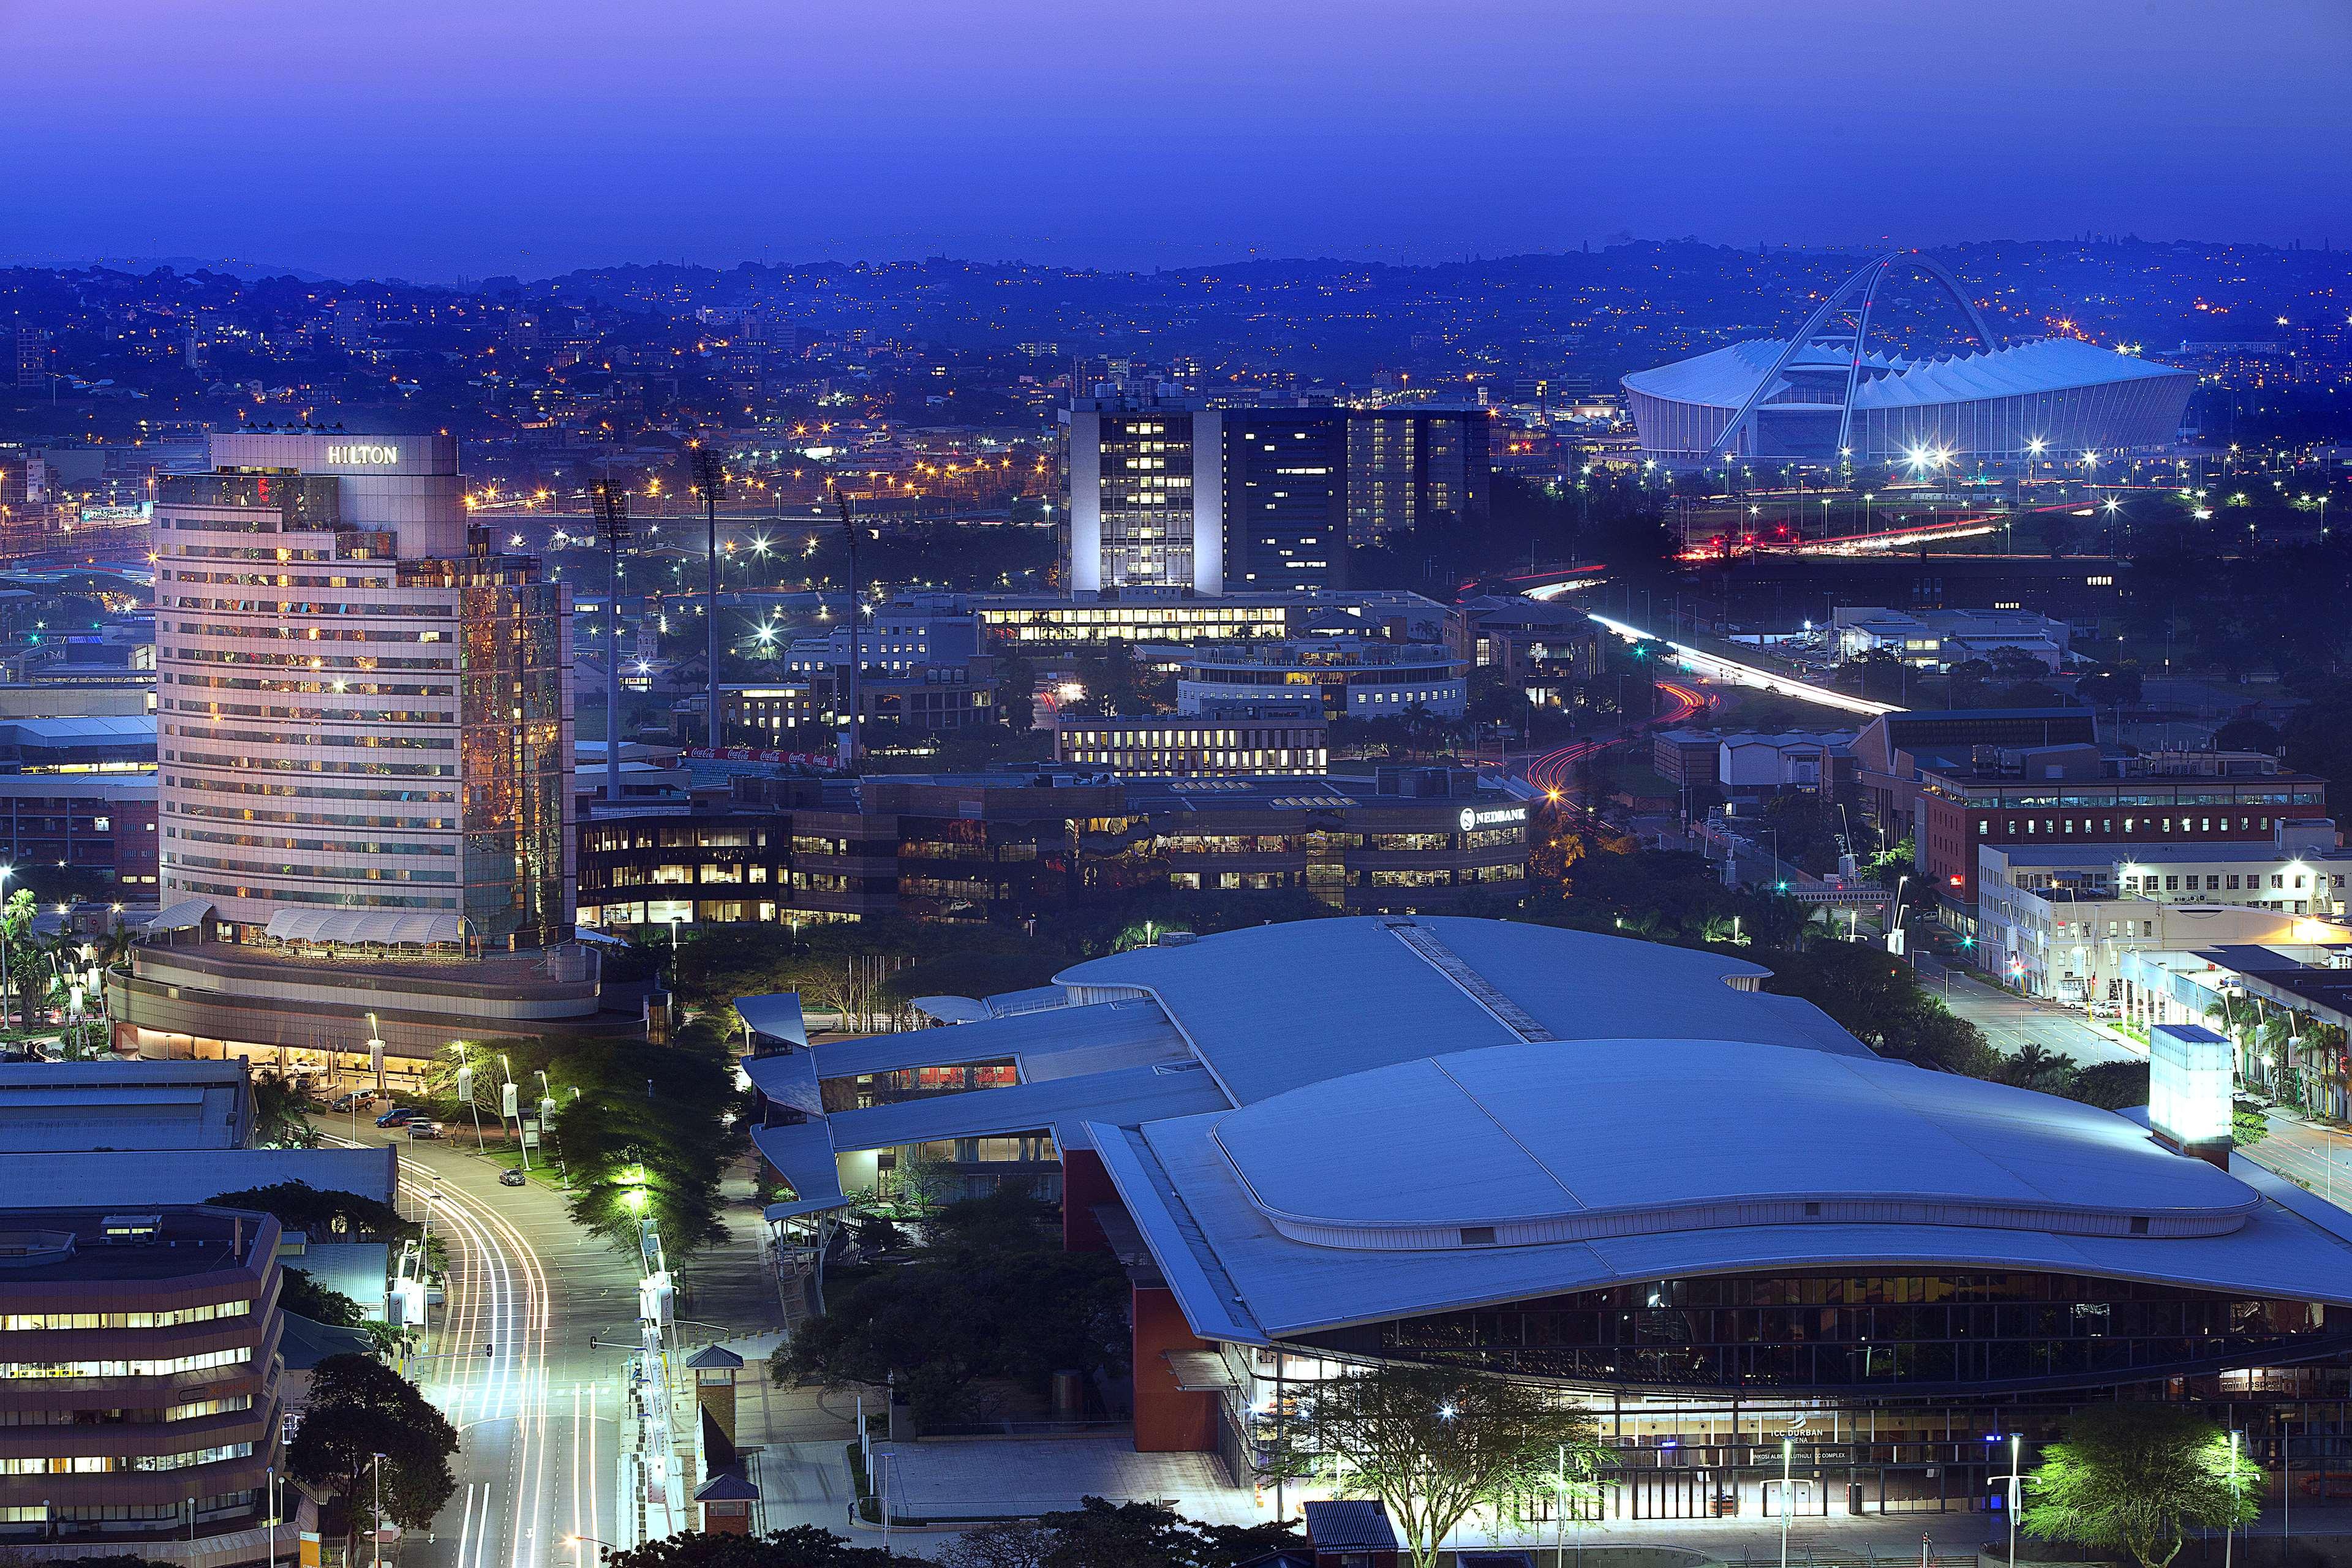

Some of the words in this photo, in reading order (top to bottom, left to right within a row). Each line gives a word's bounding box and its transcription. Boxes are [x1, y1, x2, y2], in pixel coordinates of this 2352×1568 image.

[328, 446, 398, 464] HILTON
[691, 747, 715, 758] Coca-Cola
[727, 748, 750, 760] Coca-Cola
[1476, 808, 1526, 824] NEDBANK
[1788, 1428, 1823, 1437] DURBAN
